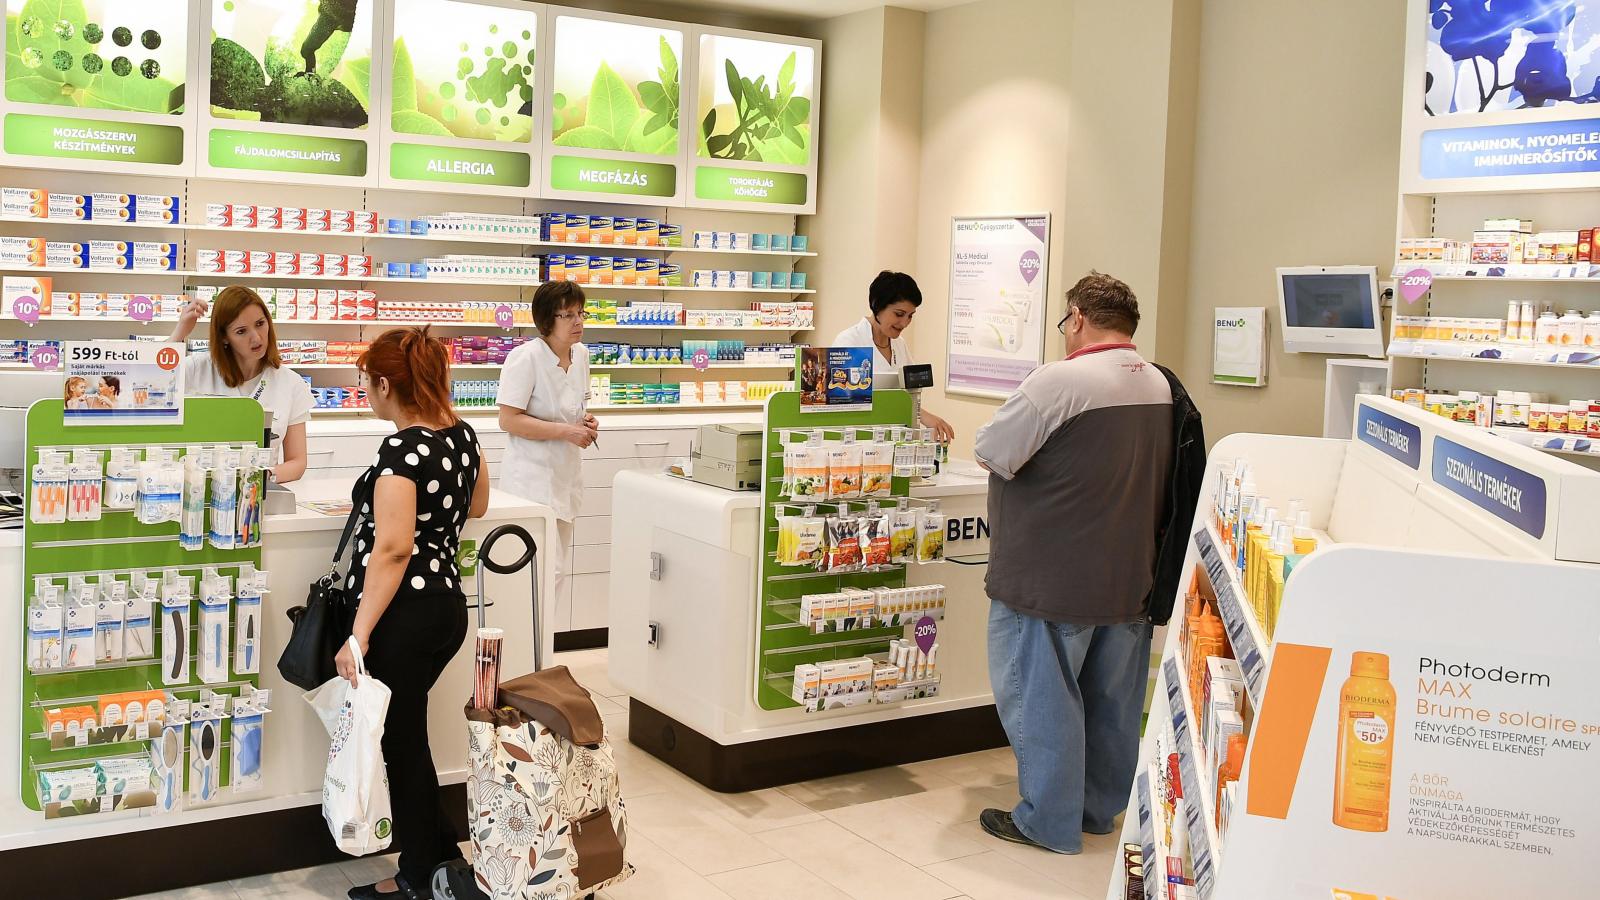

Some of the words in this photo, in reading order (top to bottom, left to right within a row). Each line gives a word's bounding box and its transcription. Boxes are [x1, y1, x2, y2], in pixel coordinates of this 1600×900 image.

[53, 128, 136, 142] MOZGÁSSZERVI
[1442, 138, 1524, 152] VITAMINOK,
[1527, 132, 1600, 148] NYOMELE
[54, 140, 136, 155] KÉSZÍTMÉNYEK
[235, 146, 340, 162] FÁJDALOMCSILLAPÍTÁS
[1474, 146, 1598, 167] IMMUNERŐSÍTŐK
[427, 159, 495, 176] ALLERGIA
[579, 168, 648, 186] MEGFÁZÁS
[728, 177, 774, 188] TOROKFÁJÁS
[734, 186, 768, 198] KÖHÖGÉS
[1020, 259, 1040, 268] -20%
[1402, 276, 1430, 286] -20%
[14, 302, 38, 314] -10%
[129, 302, 152, 314] -10%
[32, 353, 57, 364] -10%
[72, 347, 101, 360] 599
[105, 348, 139, 360] Ft-tól
[160, 350, 176, 364] ÚJ
[254, 386, 264, 400] BENU
[1366, 419, 1388, 443] SZEZONÁLIS
[1388, 429, 1409, 454] TERMÉKEK
[1446, 456, 1482, 492] SZEZONÁLIS
[1484, 474, 1523, 512] TERMÉKEK
[915, 624, 936, 636] -20%
[1419, 657, 1551, 687] Photoderm
[1418, 678, 1473, 700] MAX
[1345, 695, 1390, 705] BIODERMA
[1416, 699, 1490, 722] Brume
[1498, 712, 1577, 732] solaire
[1361, 732, 1384, 742] 50+
[1415, 721, 1476, 736] FÉNYVÉDŐ
[1480, 729, 1548, 746] TESTPERMET,
[1552, 738, 1591, 751] AMELY
[1414, 733, 1440, 744] NEM
[1443, 735, 1489, 750] IGÉNYEL
[1492, 742, 1545, 756] ELKENÉST
[1410, 772, 1418, 783] A
[1423, 773, 1448, 786] BŐR
[1409, 784, 1464, 801] ÖNMAGA
[1409, 798, 1464, 811] INSPIRÁLTA
[1466, 805, 1472, 813] A
[1475, 807, 1532, 823] BIODERMÁT,
[1534, 815, 1561, 825] HOGY
[1408, 818, 1520, 840] VÉDEKEZŐKÉPESSÉGÉT
[1409, 807, 1460, 822] AKTIVÁLJA
[1461, 814, 1502, 827] BŐRÜNK
[1505, 820, 1576, 838] TERMÉSZETES
[1415, 828, 1501, 848] NAPSUGARAKKAL
[1504, 840, 1554, 856] SZEMBEN.
